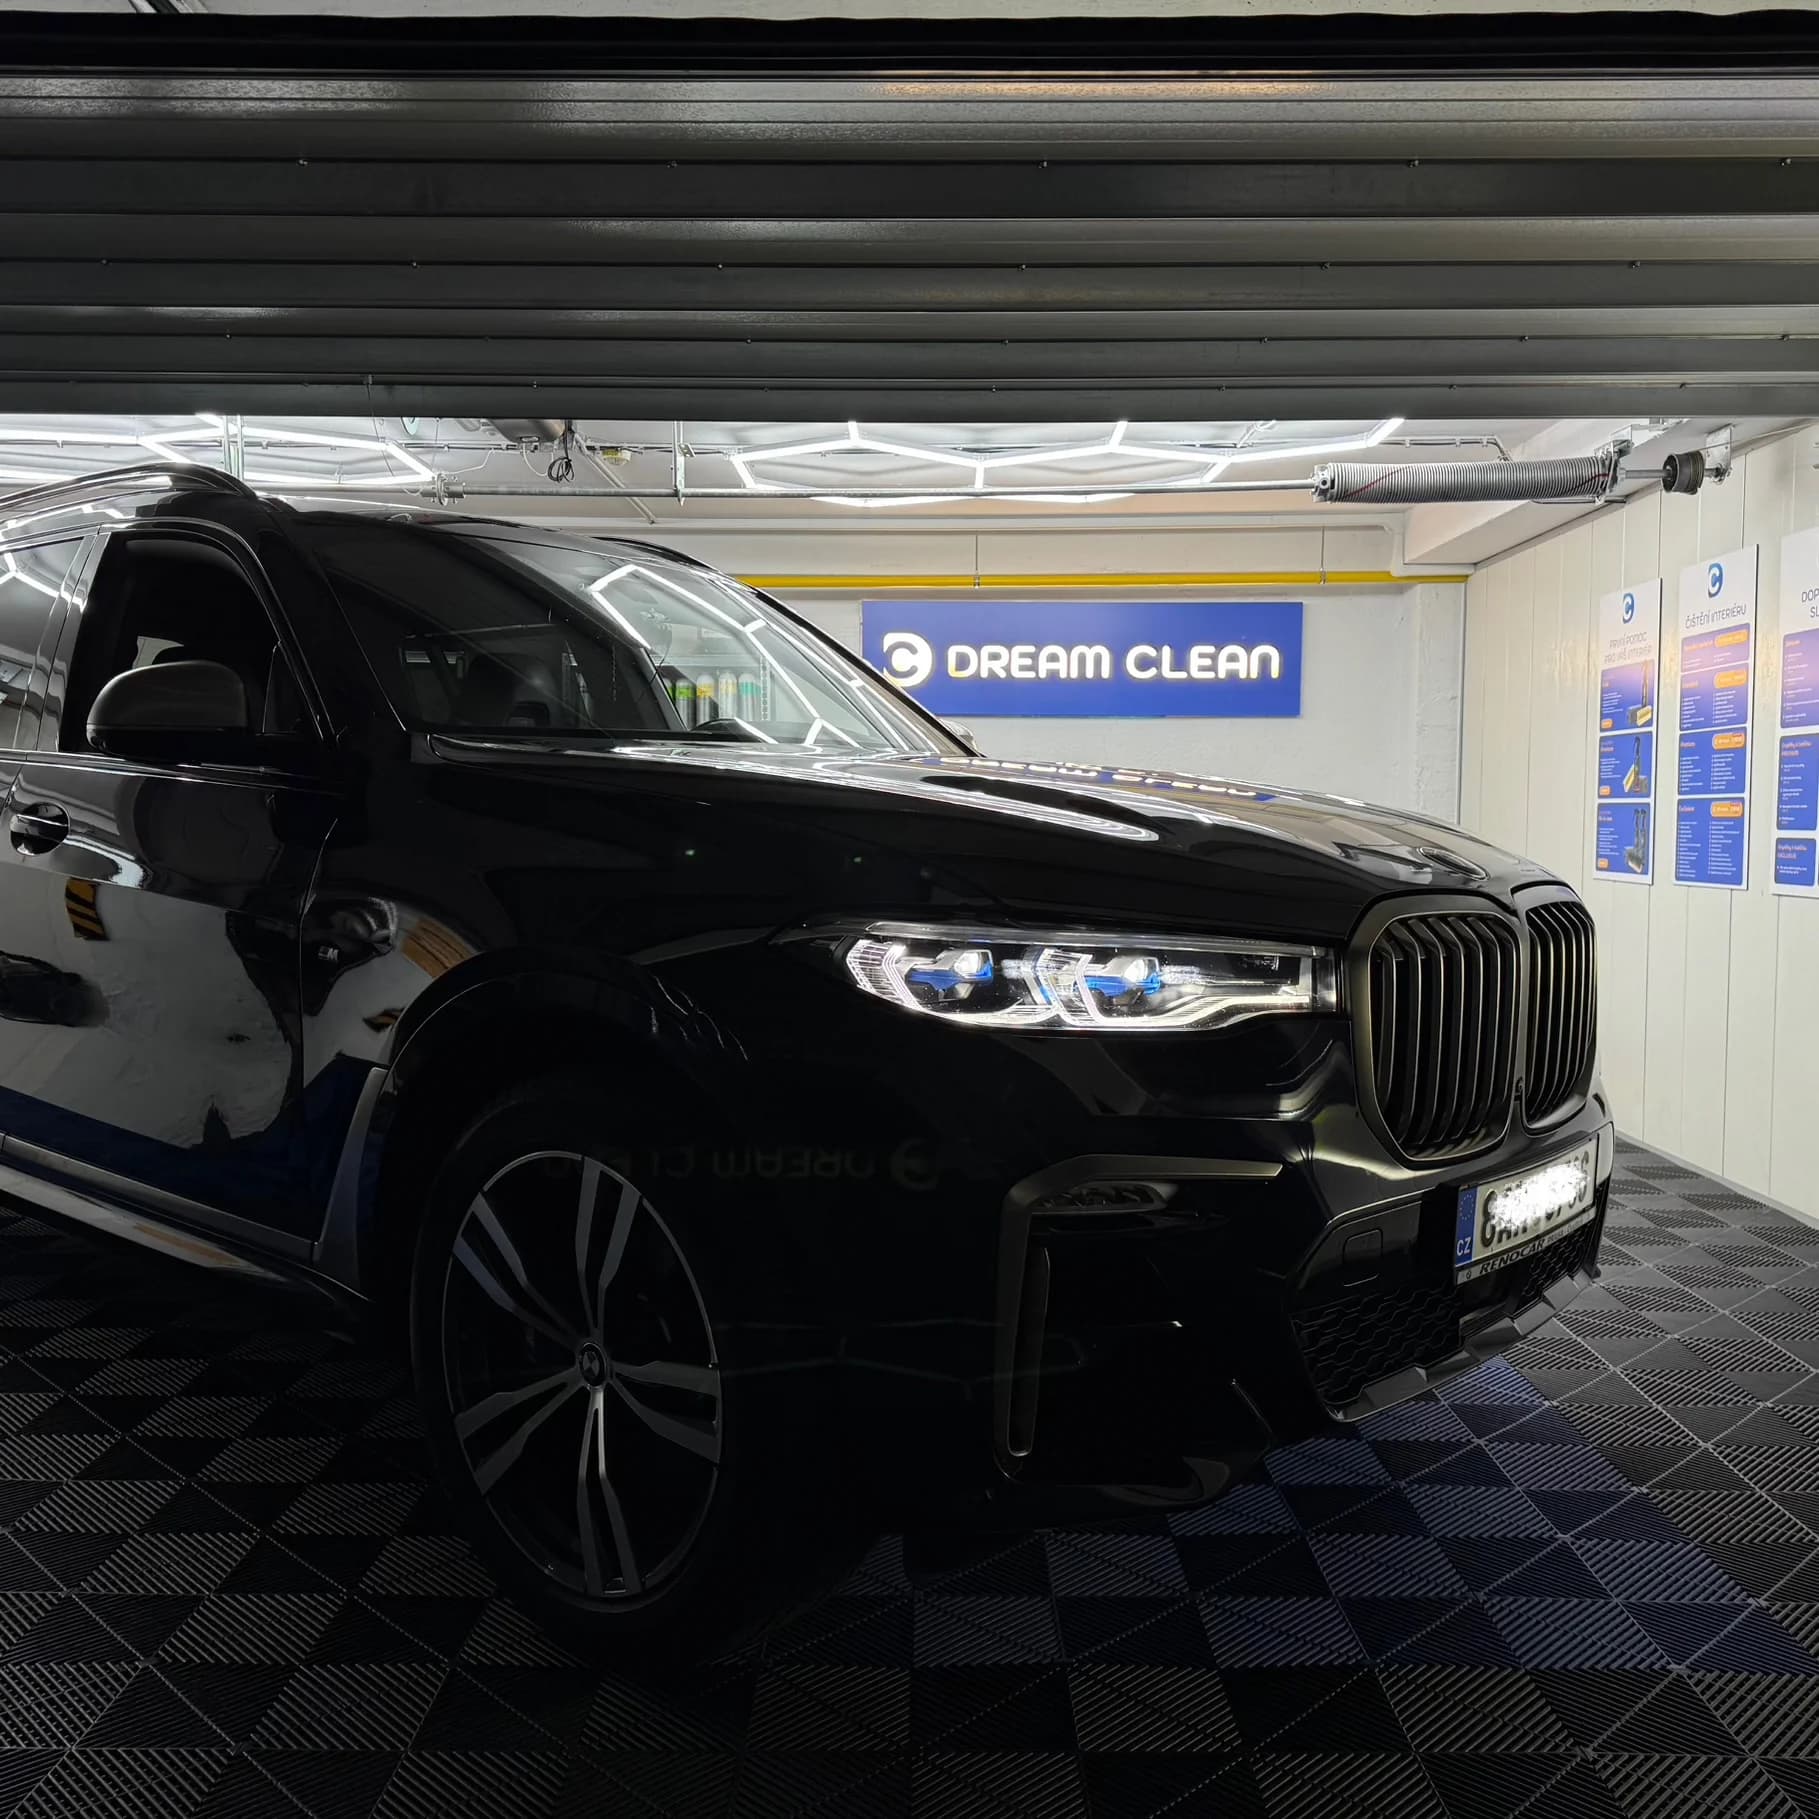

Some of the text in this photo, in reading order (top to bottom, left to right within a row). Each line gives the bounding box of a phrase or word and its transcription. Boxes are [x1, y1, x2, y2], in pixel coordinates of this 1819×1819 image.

[947, 644, 1281, 680] DREAM CLEAN
[1456, 1236, 1472, 1256] CZ
[1479, 1238, 1546, 1275] RENOCAR
